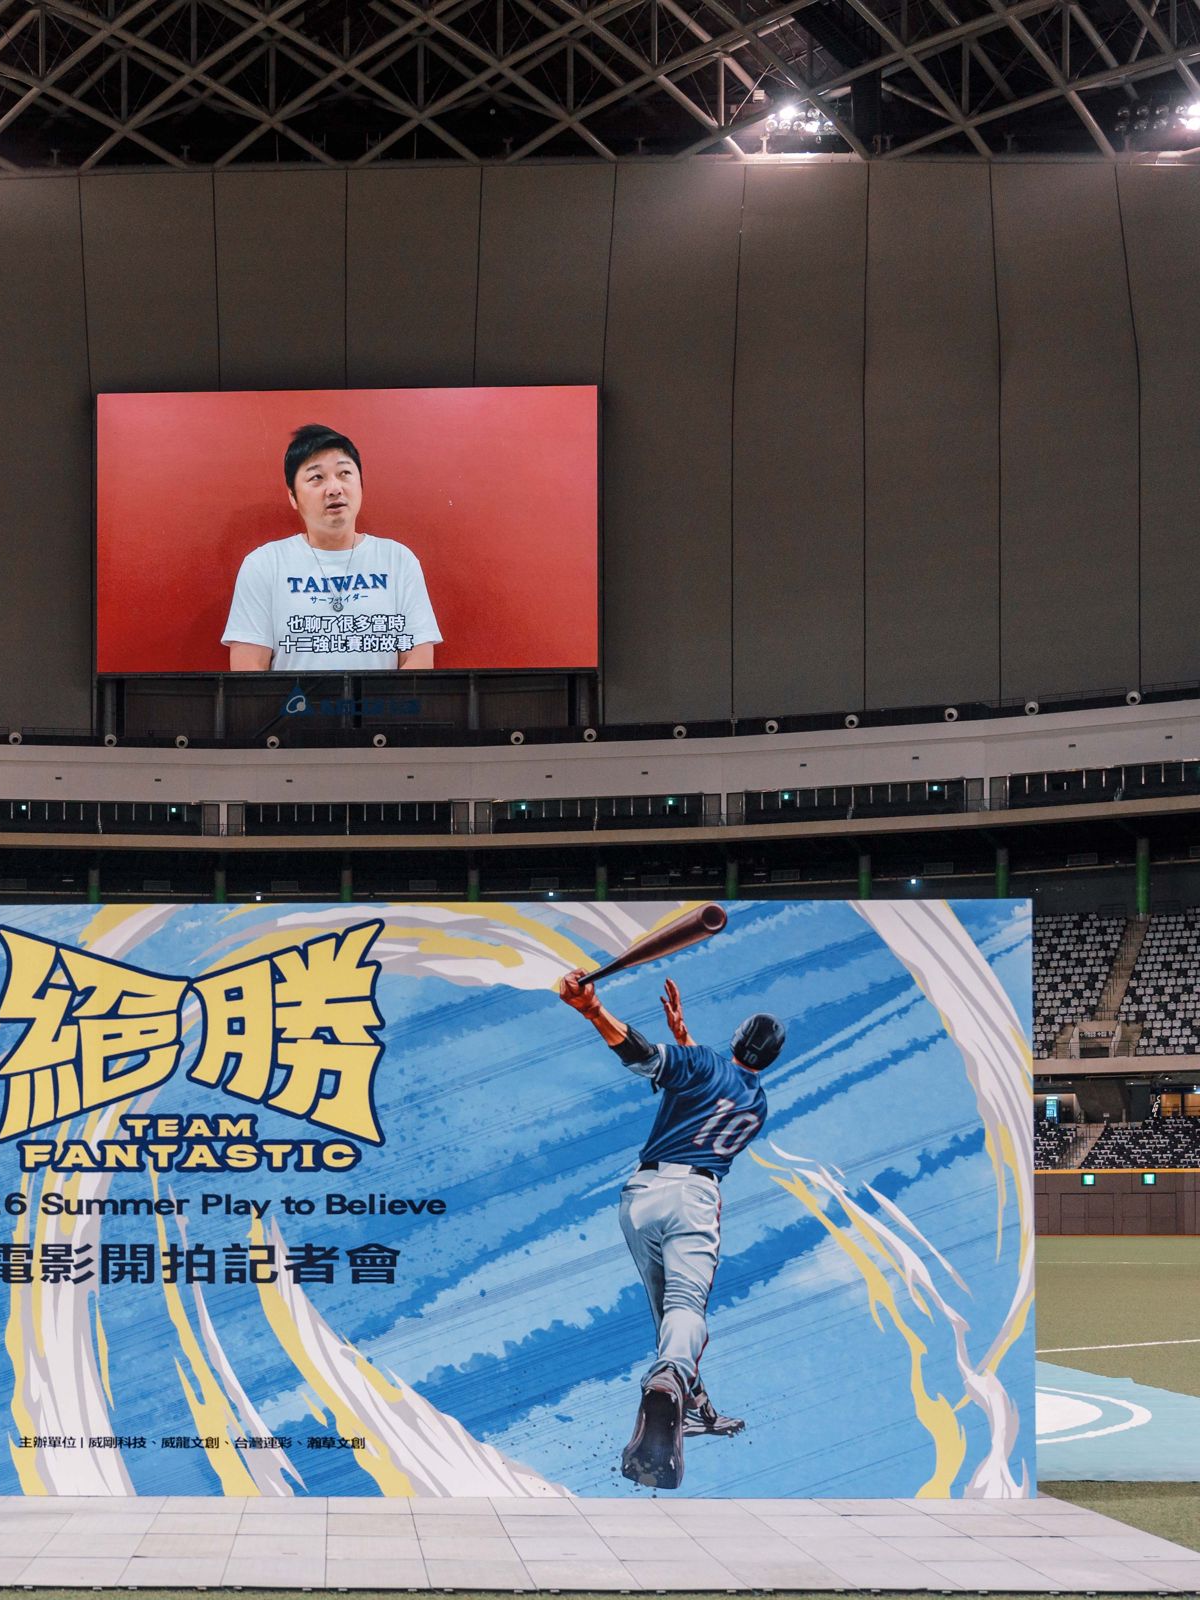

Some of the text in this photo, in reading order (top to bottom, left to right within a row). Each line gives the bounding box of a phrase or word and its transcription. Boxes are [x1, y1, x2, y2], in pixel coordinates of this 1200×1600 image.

[287, 573, 388, 593] TAIWAN
[287, 614, 406, 633] 也聊了很多當時
[279, 634, 414, 653] 十二強比賽的故事
[125, 1118, 252, 1138] TEAM
[693, 1098, 760, 1157] 10
[23, 1145, 357, 1169] FANTASTIC
[41, 1193, 188, 1215] Summer
[201, 1193, 274, 1218] Play
[284, 1194, 315, 1215] to
[326, 1193, 446, 1215] Believe
